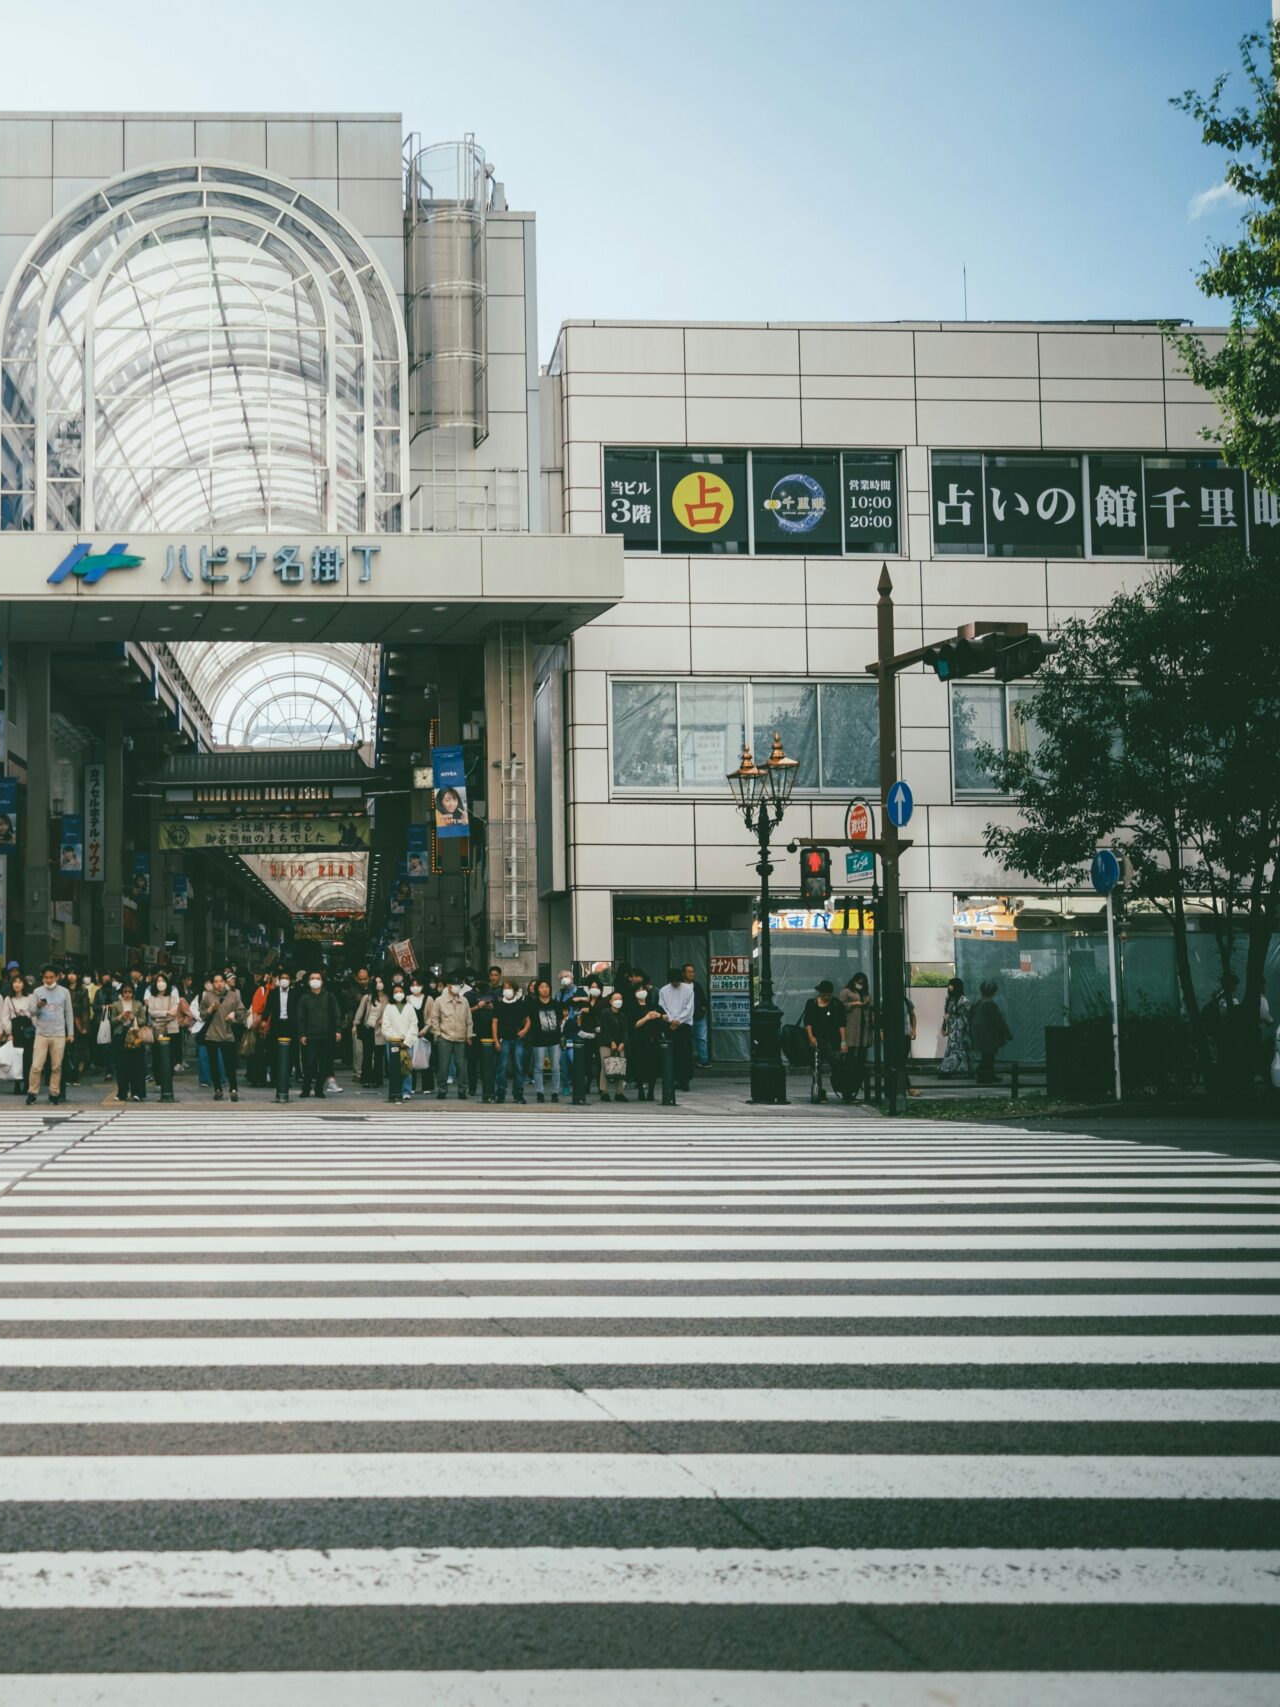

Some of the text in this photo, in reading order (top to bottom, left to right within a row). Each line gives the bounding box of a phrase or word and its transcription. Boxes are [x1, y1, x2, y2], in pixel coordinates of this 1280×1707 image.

[610, 481, 652, 496] 当ビル
[848, 480, 891, 492] 営業時間
[684, 475, 725, 528] 占
[781, 495, 827, 511] 千里眼
[850, 496, 892, 509] 10:00
[610, 498, 652, 525] 3階
[849, 515, 892, 528] 20:00
[162, 544, 382, 585] ハピナ名掛丁
[88, 766, 101, 878] カプセルホテル・サウナ
